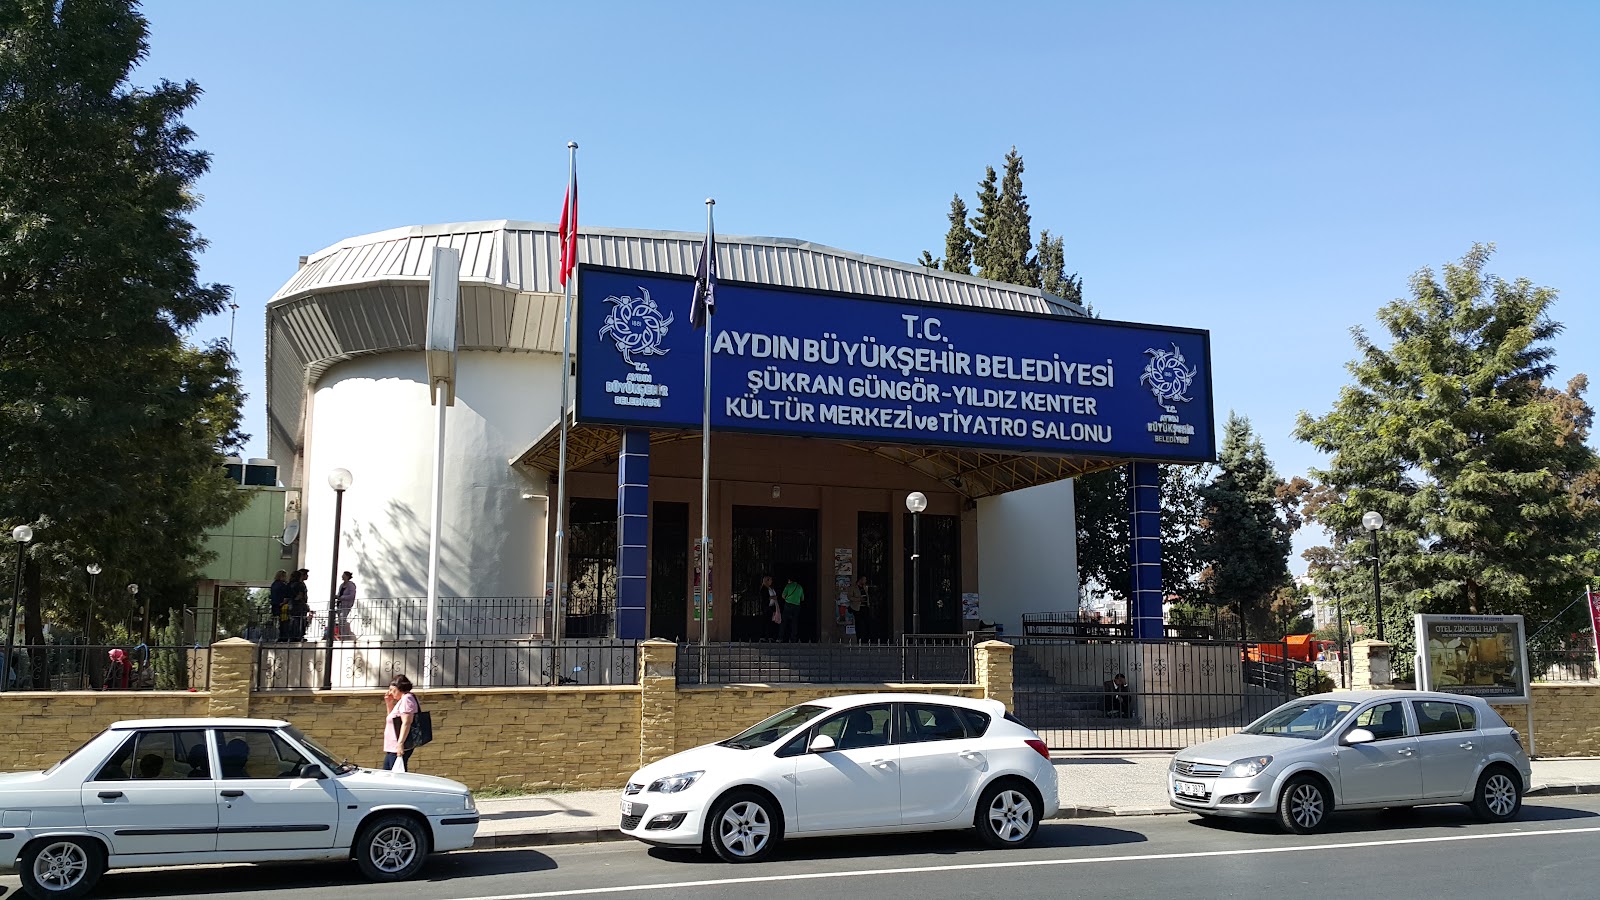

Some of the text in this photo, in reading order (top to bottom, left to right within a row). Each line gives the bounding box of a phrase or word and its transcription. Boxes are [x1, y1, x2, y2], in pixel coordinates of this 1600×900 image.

[902, 314, 949, 342] T.C.
[634, 361, 650, 372] T.C.
[713, 329, 1114, 388] AYDIN BÜYÜKŞEHİR BELEDİYESİ
[626, 373, 652, 383] AYDIN
[605, 380, 669, 397] BÜYÜKŞEHİR
[747, 366, 844, 394] ŞÜKRAN
[1021, 391, 1098, 415] KENTER
[614, 396, 662, 408] BELEDİYESİ
[726, 393, 1113, 443] KÜLTÜR MERKEZİ ve TİYATRO SALONU
[1435, 624, 1498, 633] OTEL ZİNCİRLİ HAN
